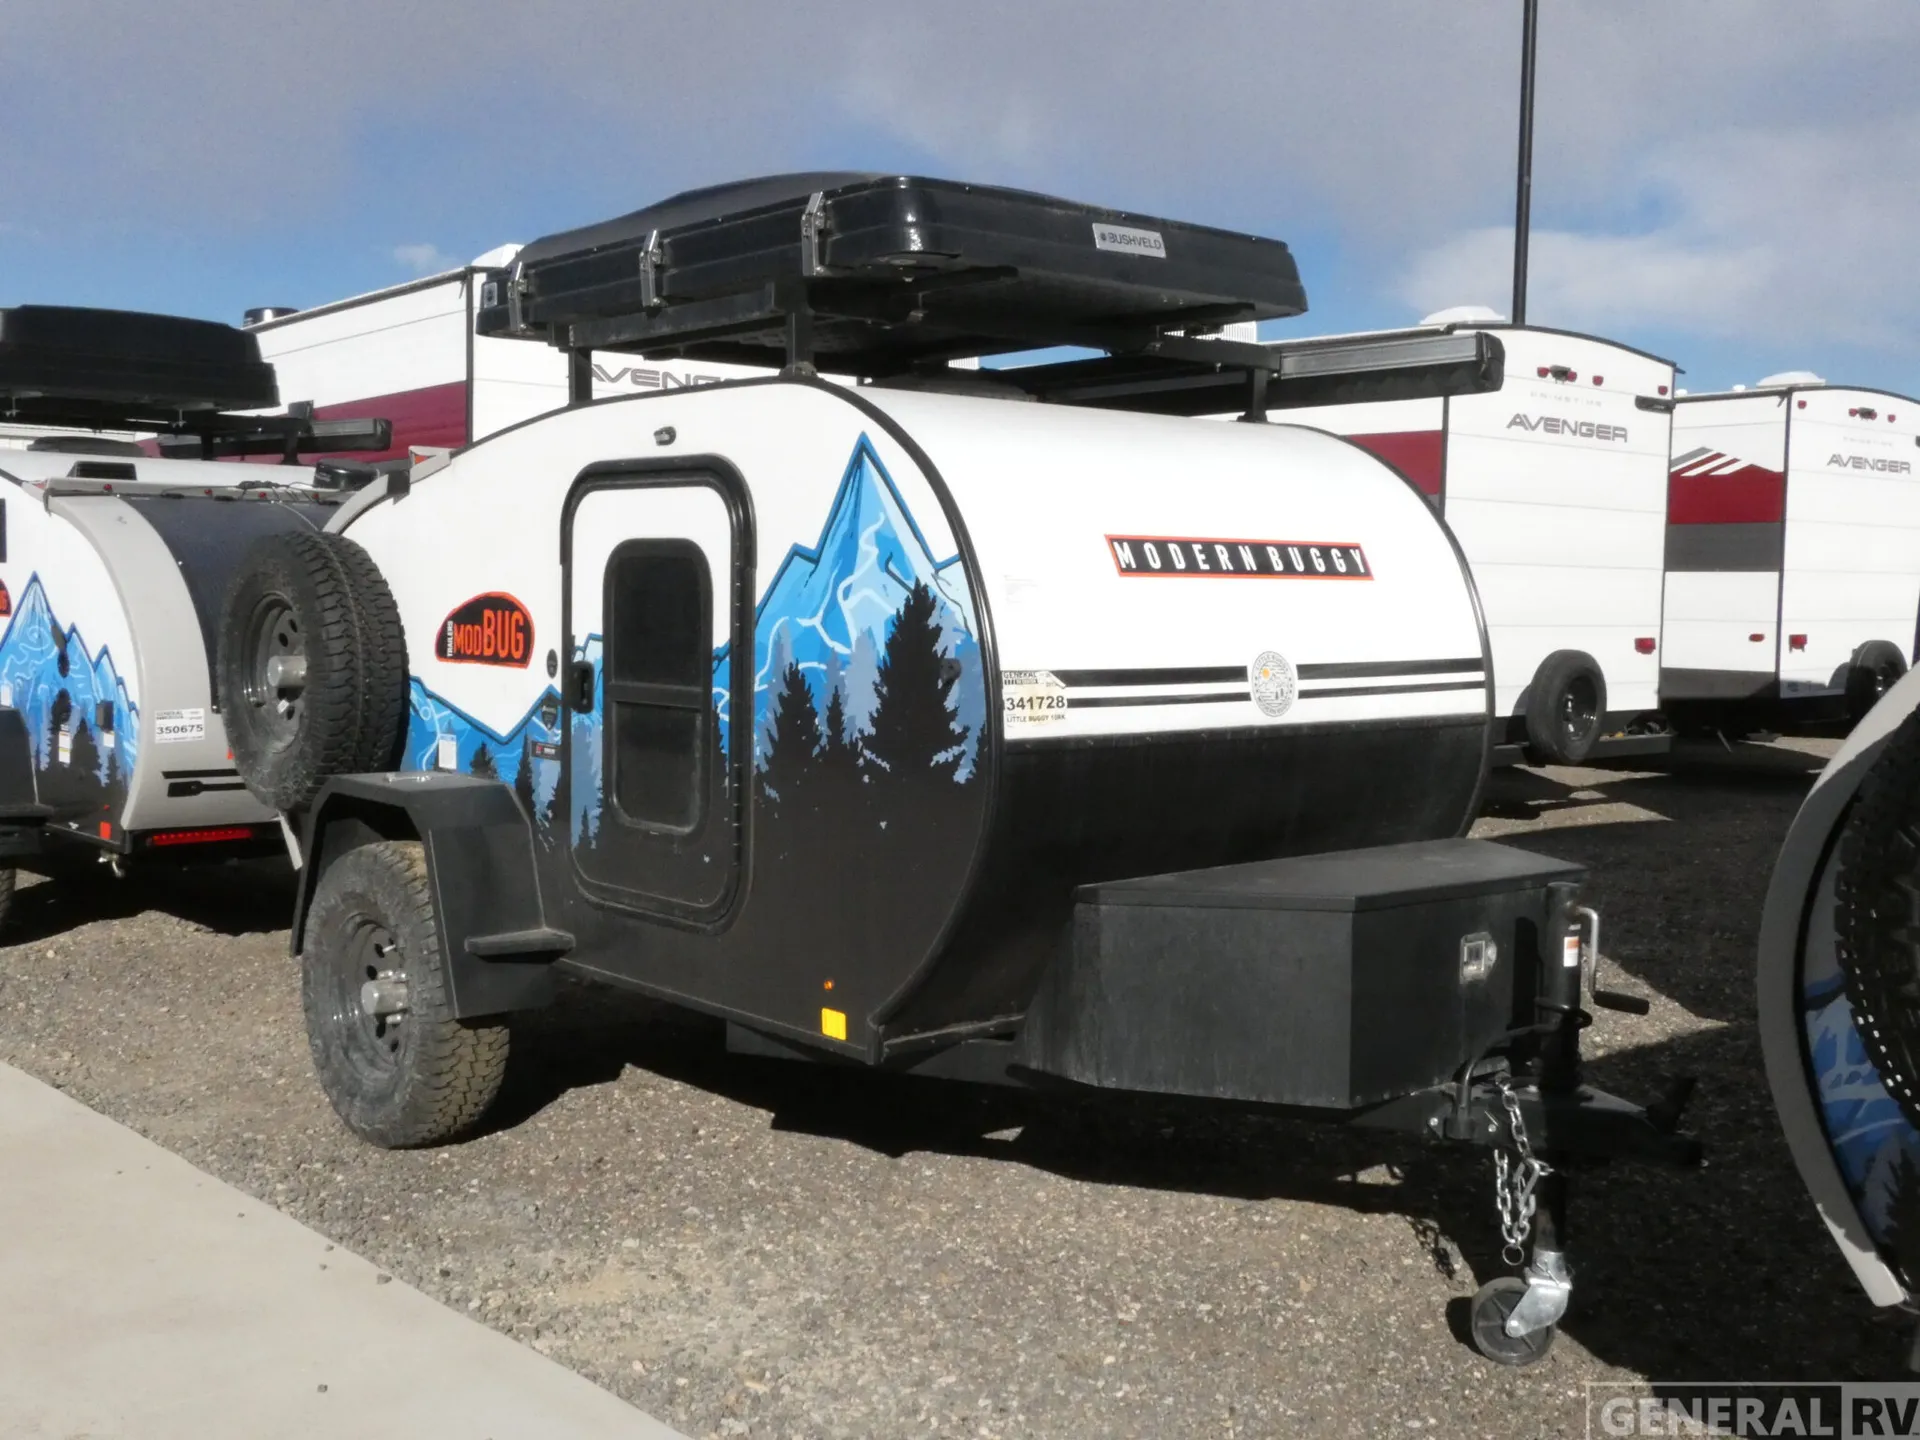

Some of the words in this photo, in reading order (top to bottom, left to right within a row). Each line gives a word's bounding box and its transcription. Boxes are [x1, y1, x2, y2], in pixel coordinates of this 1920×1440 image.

[1107, 232, 1162, 250] BUSHVELD
[1506, 413, 1628, 443] AVENGER
[1827, 454, 1911, 475] AVENGER
[1113, 541, 1257, 571] MODERN
[1266, 546, 1365, 573] BUGGY
[1005, 695, 1066, 711] 341728
[156, 724, 203, 735] 350675
